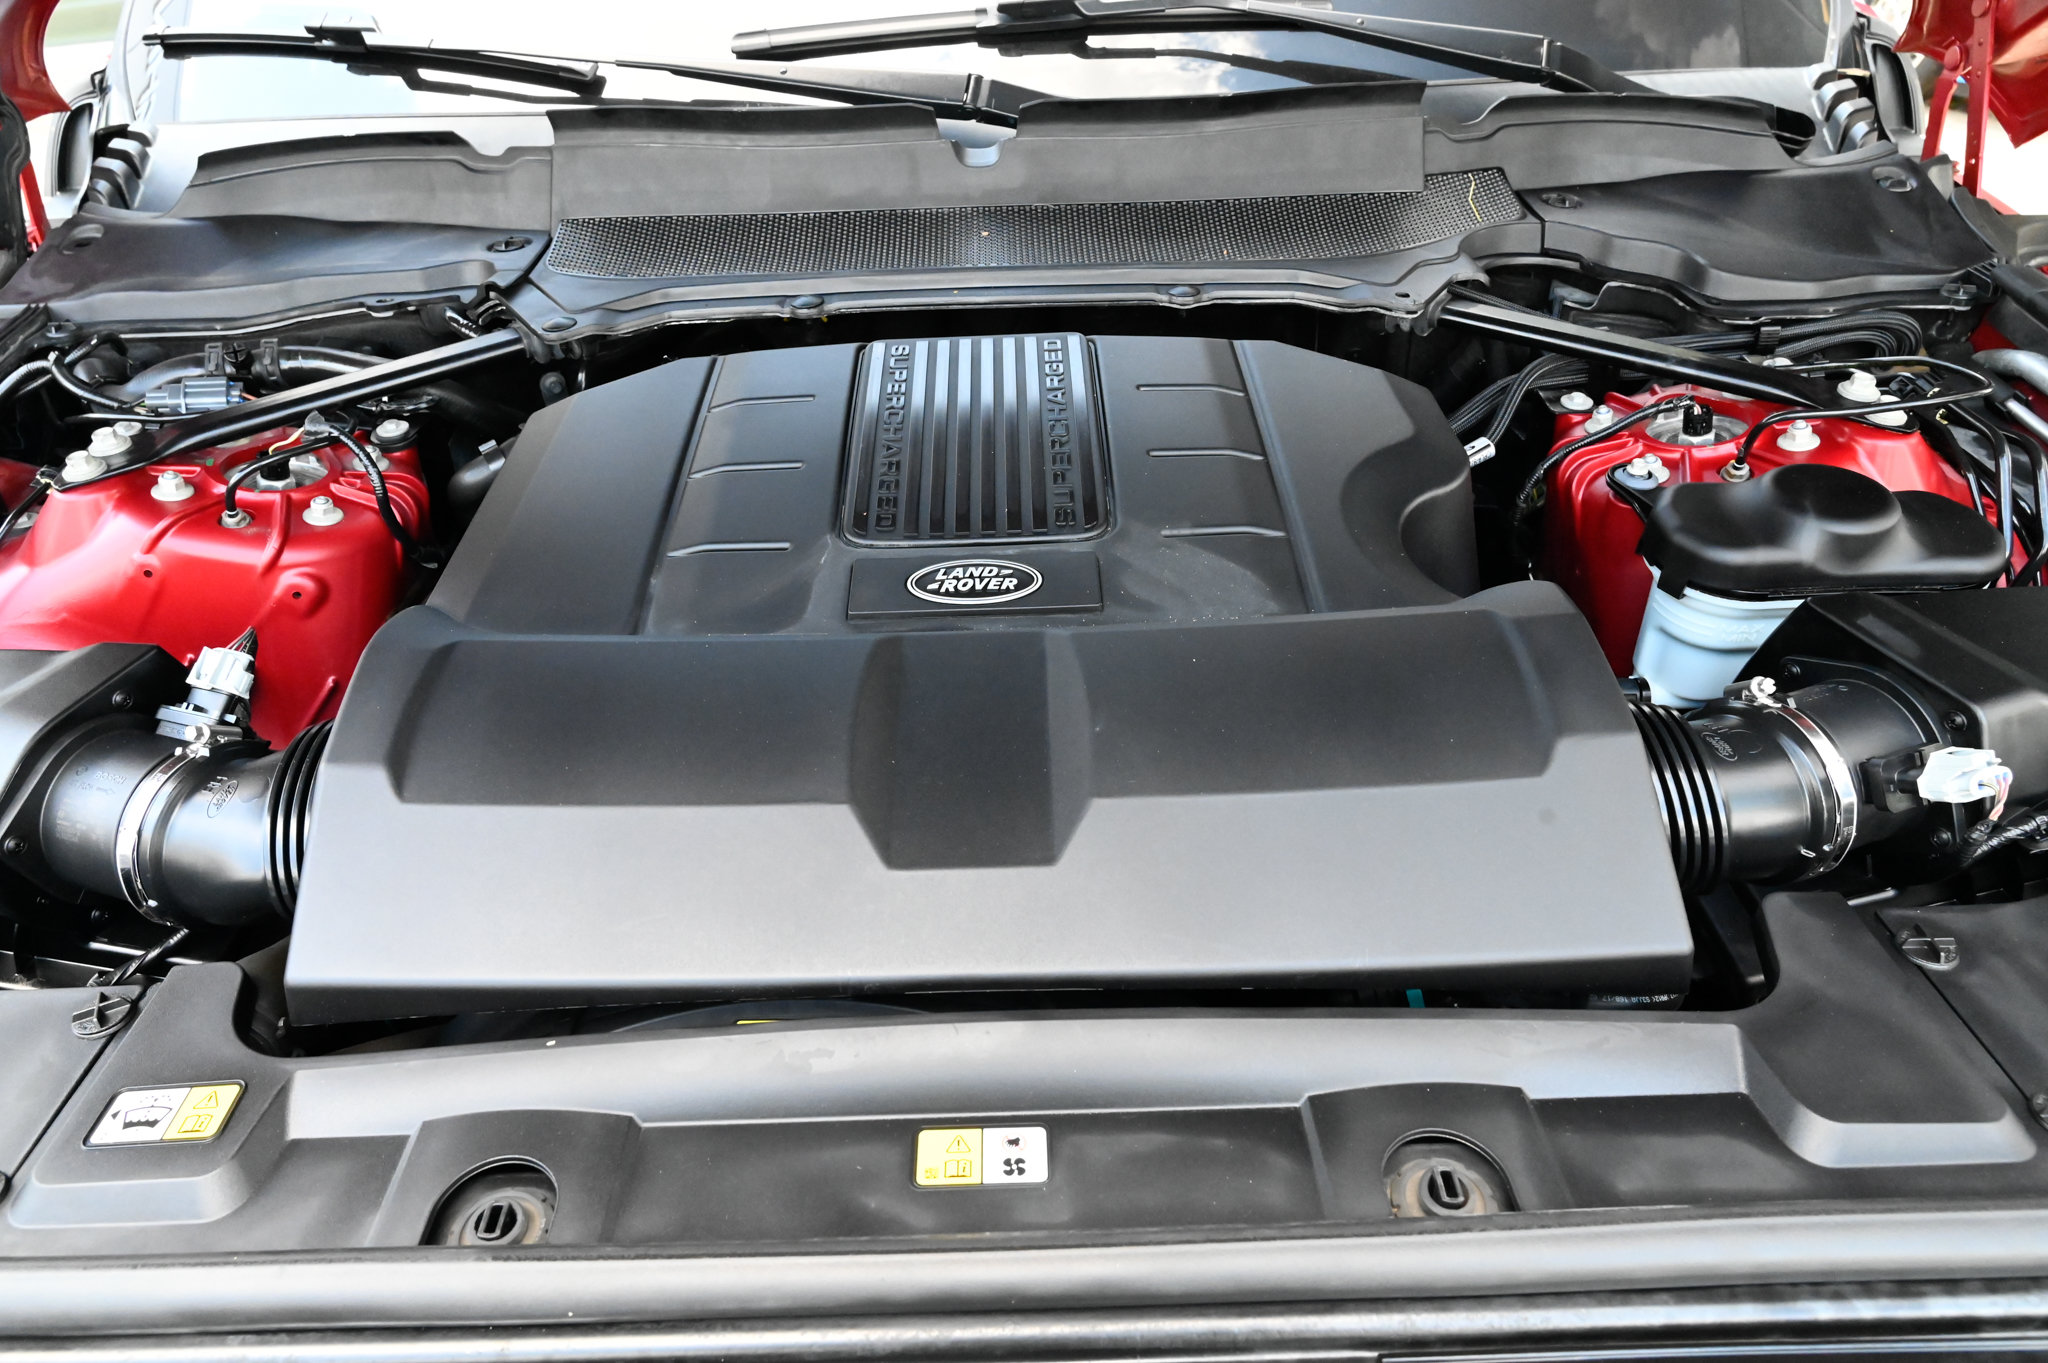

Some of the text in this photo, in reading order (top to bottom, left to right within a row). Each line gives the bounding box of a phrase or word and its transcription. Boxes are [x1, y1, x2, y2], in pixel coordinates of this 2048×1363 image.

[875, 344, 910, 532] SUPERCHARGED
[1043, 338, 1076, 528] SUPERCHARGED
[935, 566, 999, 580] LAND
[939, 577, 1019, 593] ROVER
